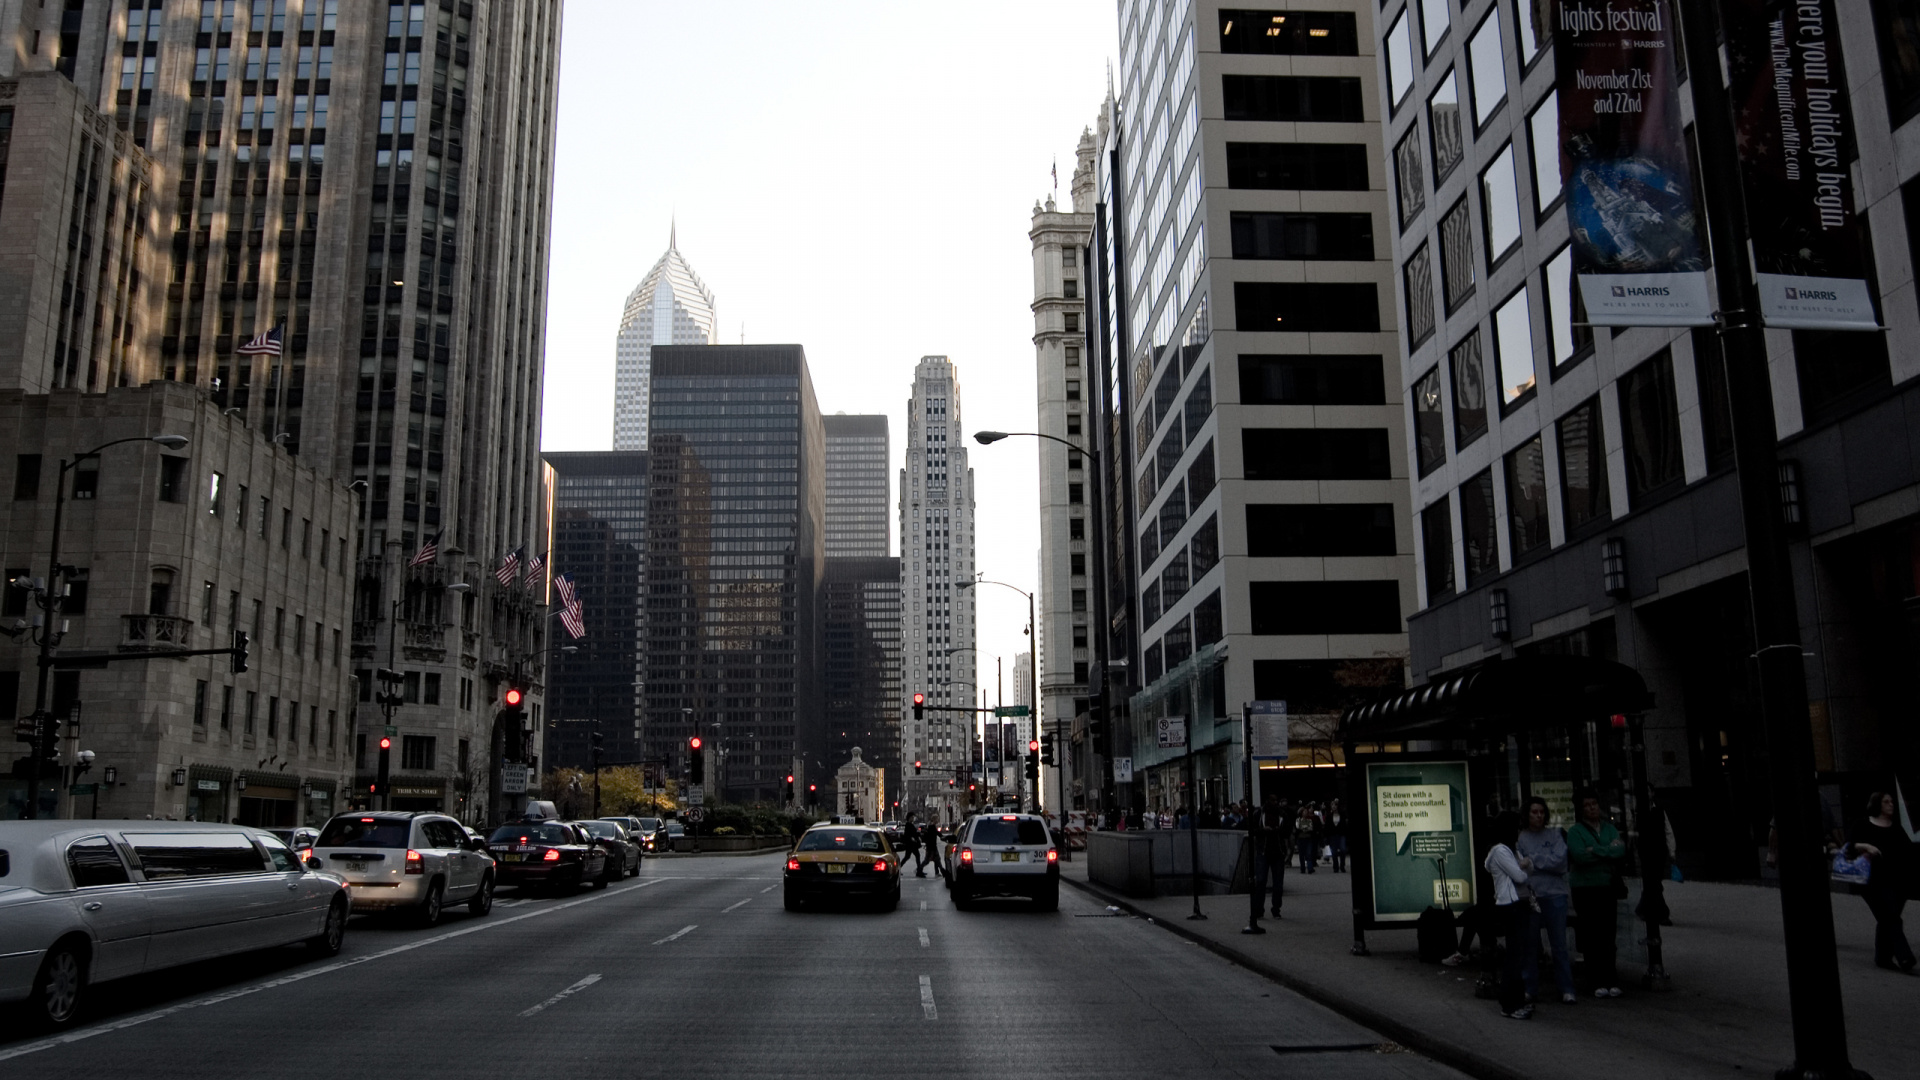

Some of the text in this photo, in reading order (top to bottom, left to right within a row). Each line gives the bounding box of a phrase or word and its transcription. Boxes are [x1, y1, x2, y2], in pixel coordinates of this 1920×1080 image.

[1559, 0, 1662, 37] lights festival
[1633, 40, 1665, 49] HARRIS
[1796, 41, 1830, 84] your
[1576, 68, 1653, 90] November 21st
[1593, 92, 1642, 113] and 22nd
[1768, 20, 1801, 180] www.TheMagnificentMile.com
[1806, 87, 1843, 167] holidays
[1813, 173, 1850, 231] begin.
[1627, 287, 1670, 296] HARRIS
[1799, 290, 1837, 301] HARRIS
[1382, 791, 1391, 799] Sit
[1393, 791, 1410, 799] down
[1390, 820, 1406, 828] plan.
[857, 855, 873, 863] 1065
[1033, 850, 1048, 858] 309
